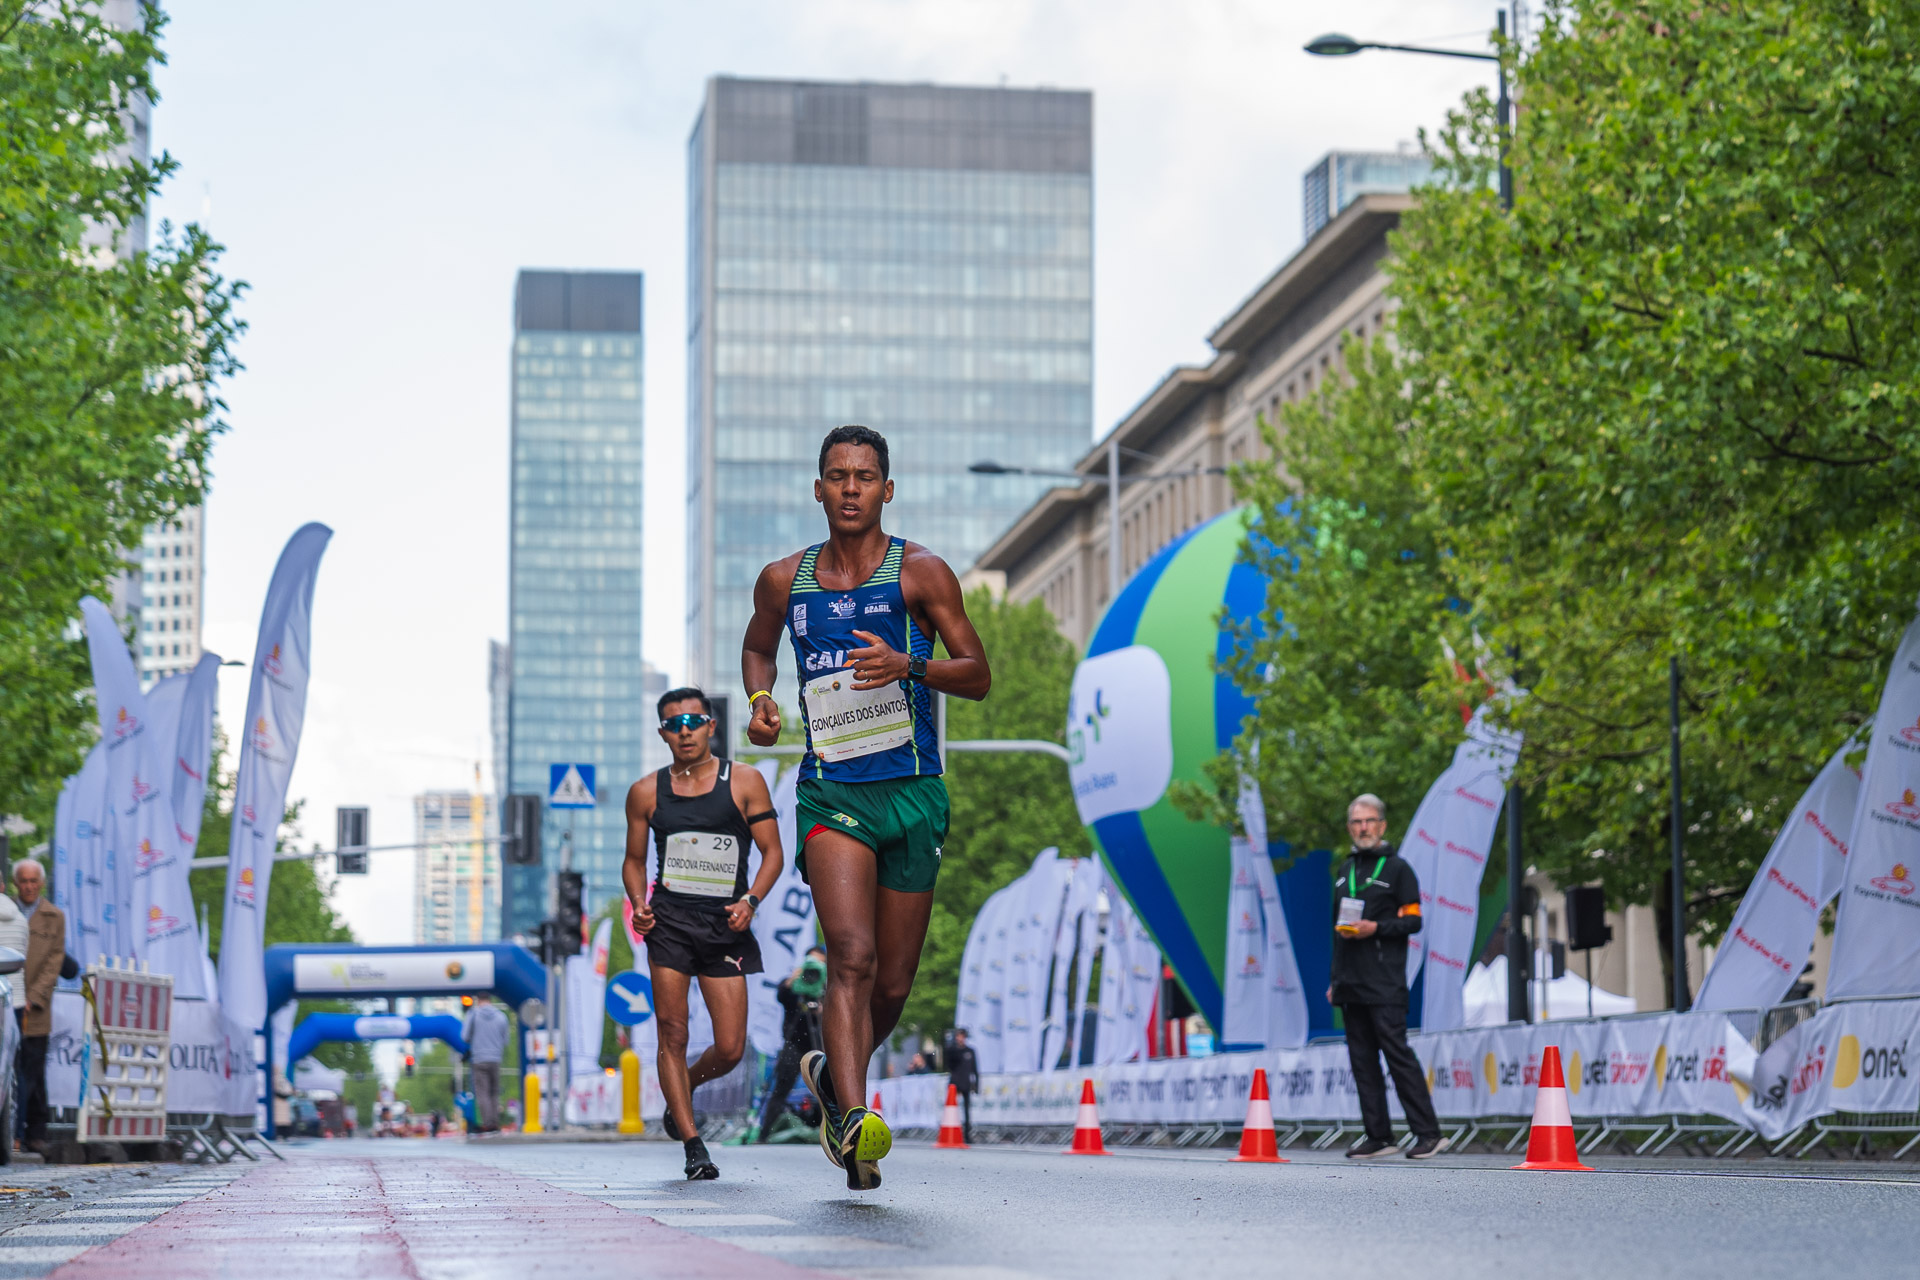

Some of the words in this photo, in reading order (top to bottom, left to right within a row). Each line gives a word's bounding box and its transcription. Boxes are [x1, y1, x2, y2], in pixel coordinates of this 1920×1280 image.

[811, 710, 856, 732] GONÇALVES
[856, 706, 874, 721] DOS
[874, 698, 907, 717] SANTOS
[712, 837, 733, 851] 29
[666, 857, 698, 870] CORDOVA
[698, 860, 736, 874] FERNANDEZ
[1862, 1039, 1907, 1079] onet
